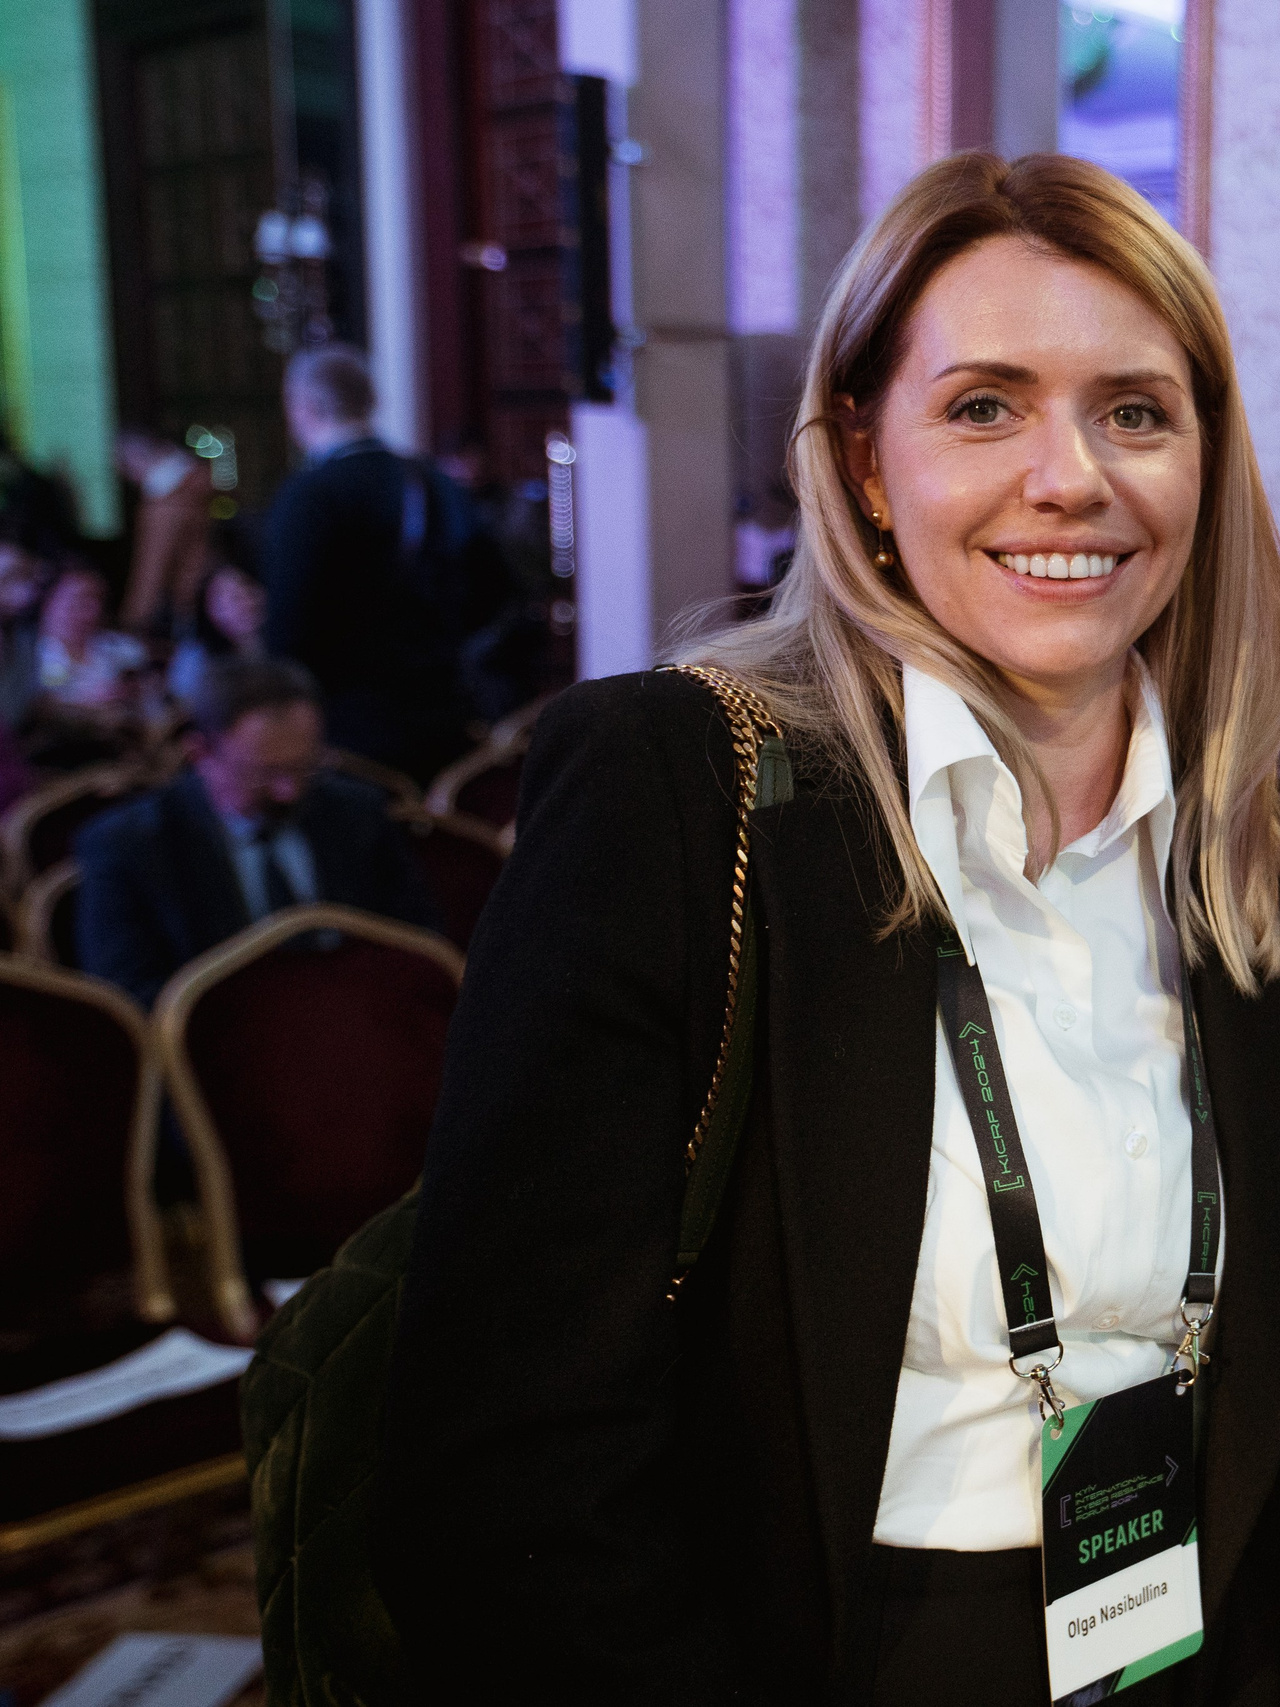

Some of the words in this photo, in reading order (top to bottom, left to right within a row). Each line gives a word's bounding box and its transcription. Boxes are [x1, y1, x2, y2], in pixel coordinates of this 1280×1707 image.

[970, 1038, 993, 1103] 2024
[986, 1109, 1011, 1174] KICRF
[1201, 1207, 1211, 1271] KICRF
[1021, 1281, 1037, 1325] 024
[1075, 1474, 1147, 1505] INTERNATIONAL
[1075, 1496, 1109, 1514] CYBER
[1075, 1505, 1110, 1522] FORUM
[1110, 1492, 1138, 1509] 2024
[1078, 1509, 1164, 1564] SPEAKER
[1067, 1615, 1096, 1639] Olga
[1100, 1581, 1168, 1624] Nasibullina
